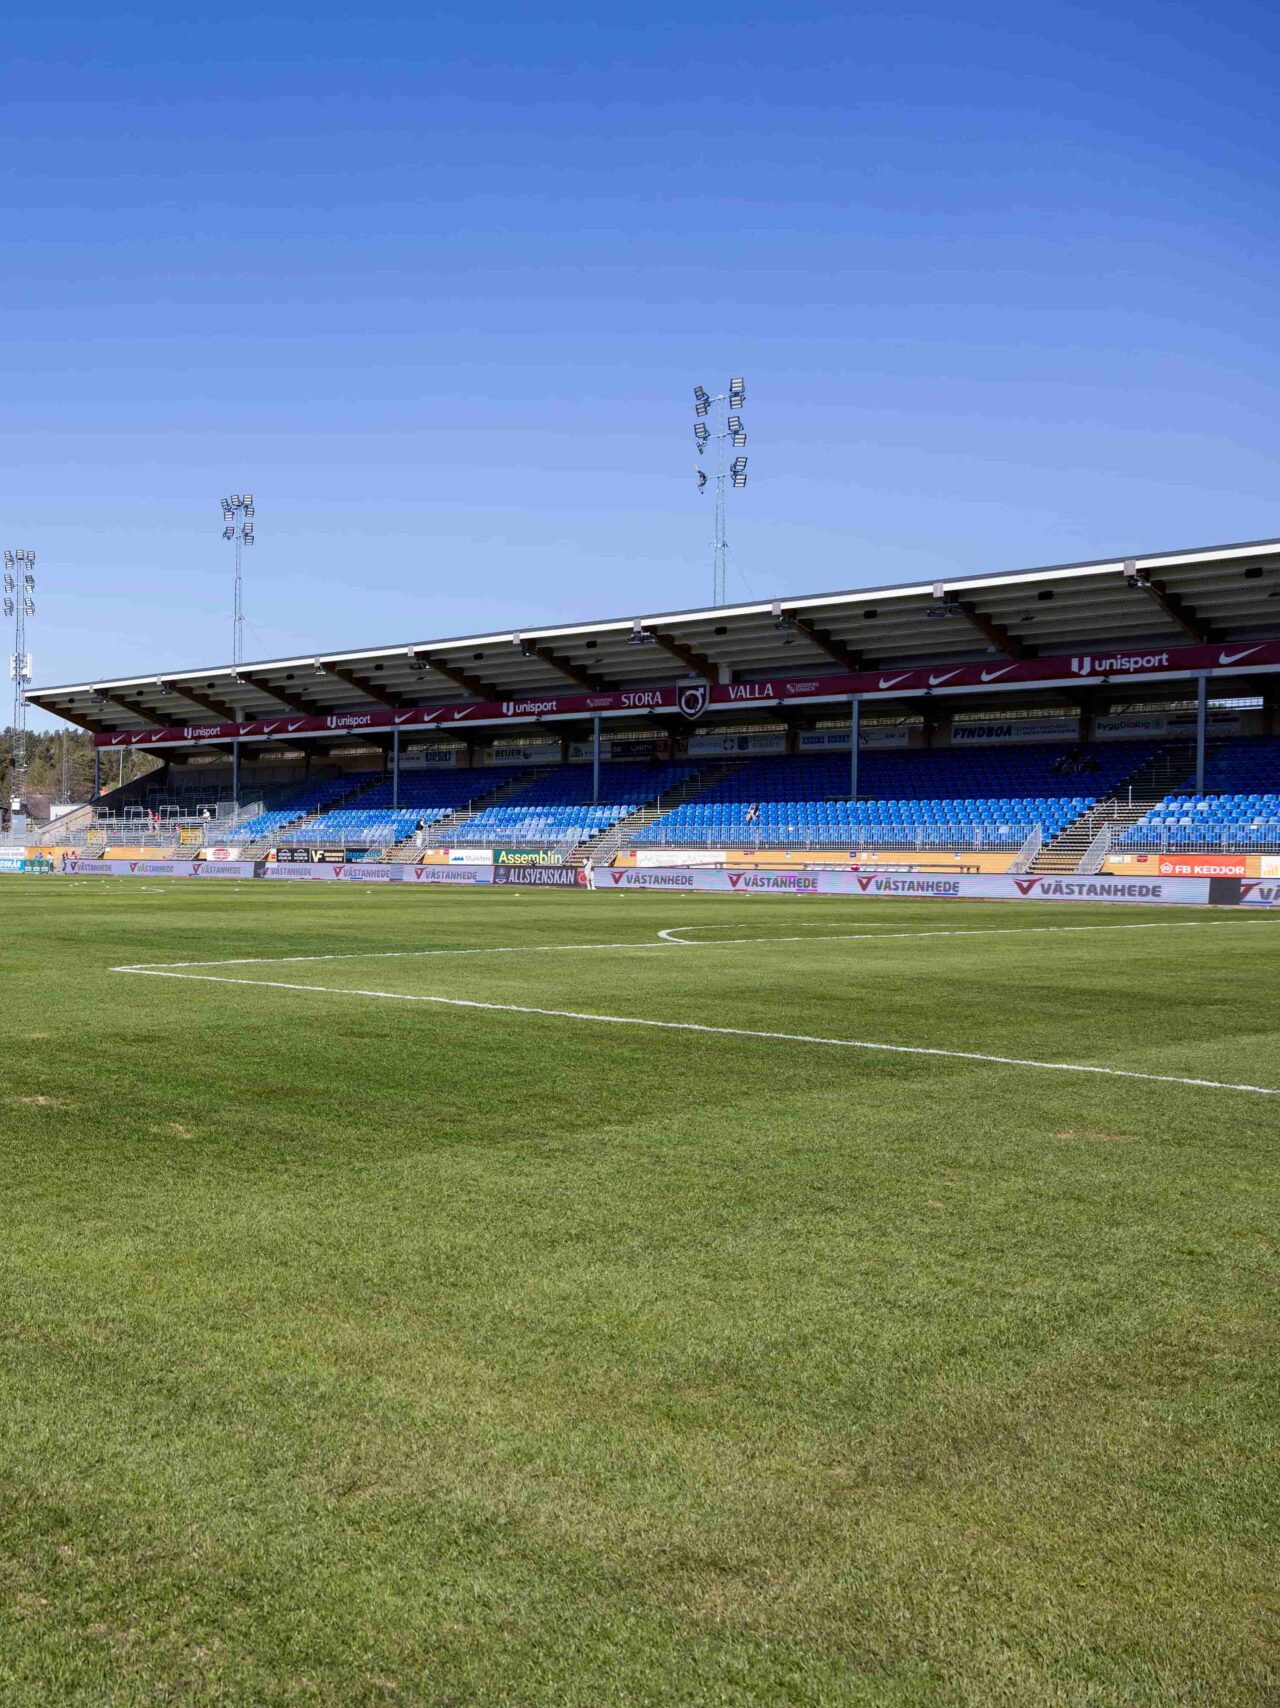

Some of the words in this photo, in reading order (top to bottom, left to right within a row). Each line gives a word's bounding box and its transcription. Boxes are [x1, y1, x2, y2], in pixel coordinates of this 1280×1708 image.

[1094, 652, 1169, 672] unisport
[728, 683, 773, 699] VALLA
[621, 691, 662, 706] STORA
[515, 700, 557, 714] unisport
[337, 714, 371, 727] unisport
[192, 726, 220, 738] unisport
[498, 851, 562, 864] Assemblin
[201, 864, 241, 874] VÄSTANHEDE
[271, 866, 312, 877] VÄSTANHEDE
[343, 866, 390, 878] VÄSTANHEDE
[425, 869, 478, 880] VÄSTANHEDE
[1175, 865, 1191, 873] FB
[1194, 865, 1245, 875] KEDJOR
[509, 871, 575, 885] ALLSVENSKAN
[626, 873, 694, 886] VÄSTANHEDE
[744, 875, 818, 889] VÄSTANHEDE
[875, 878, 960, 892] VÄSTANHEDE
[1040, 880, 1162, 898] VÄSTANHEDE
